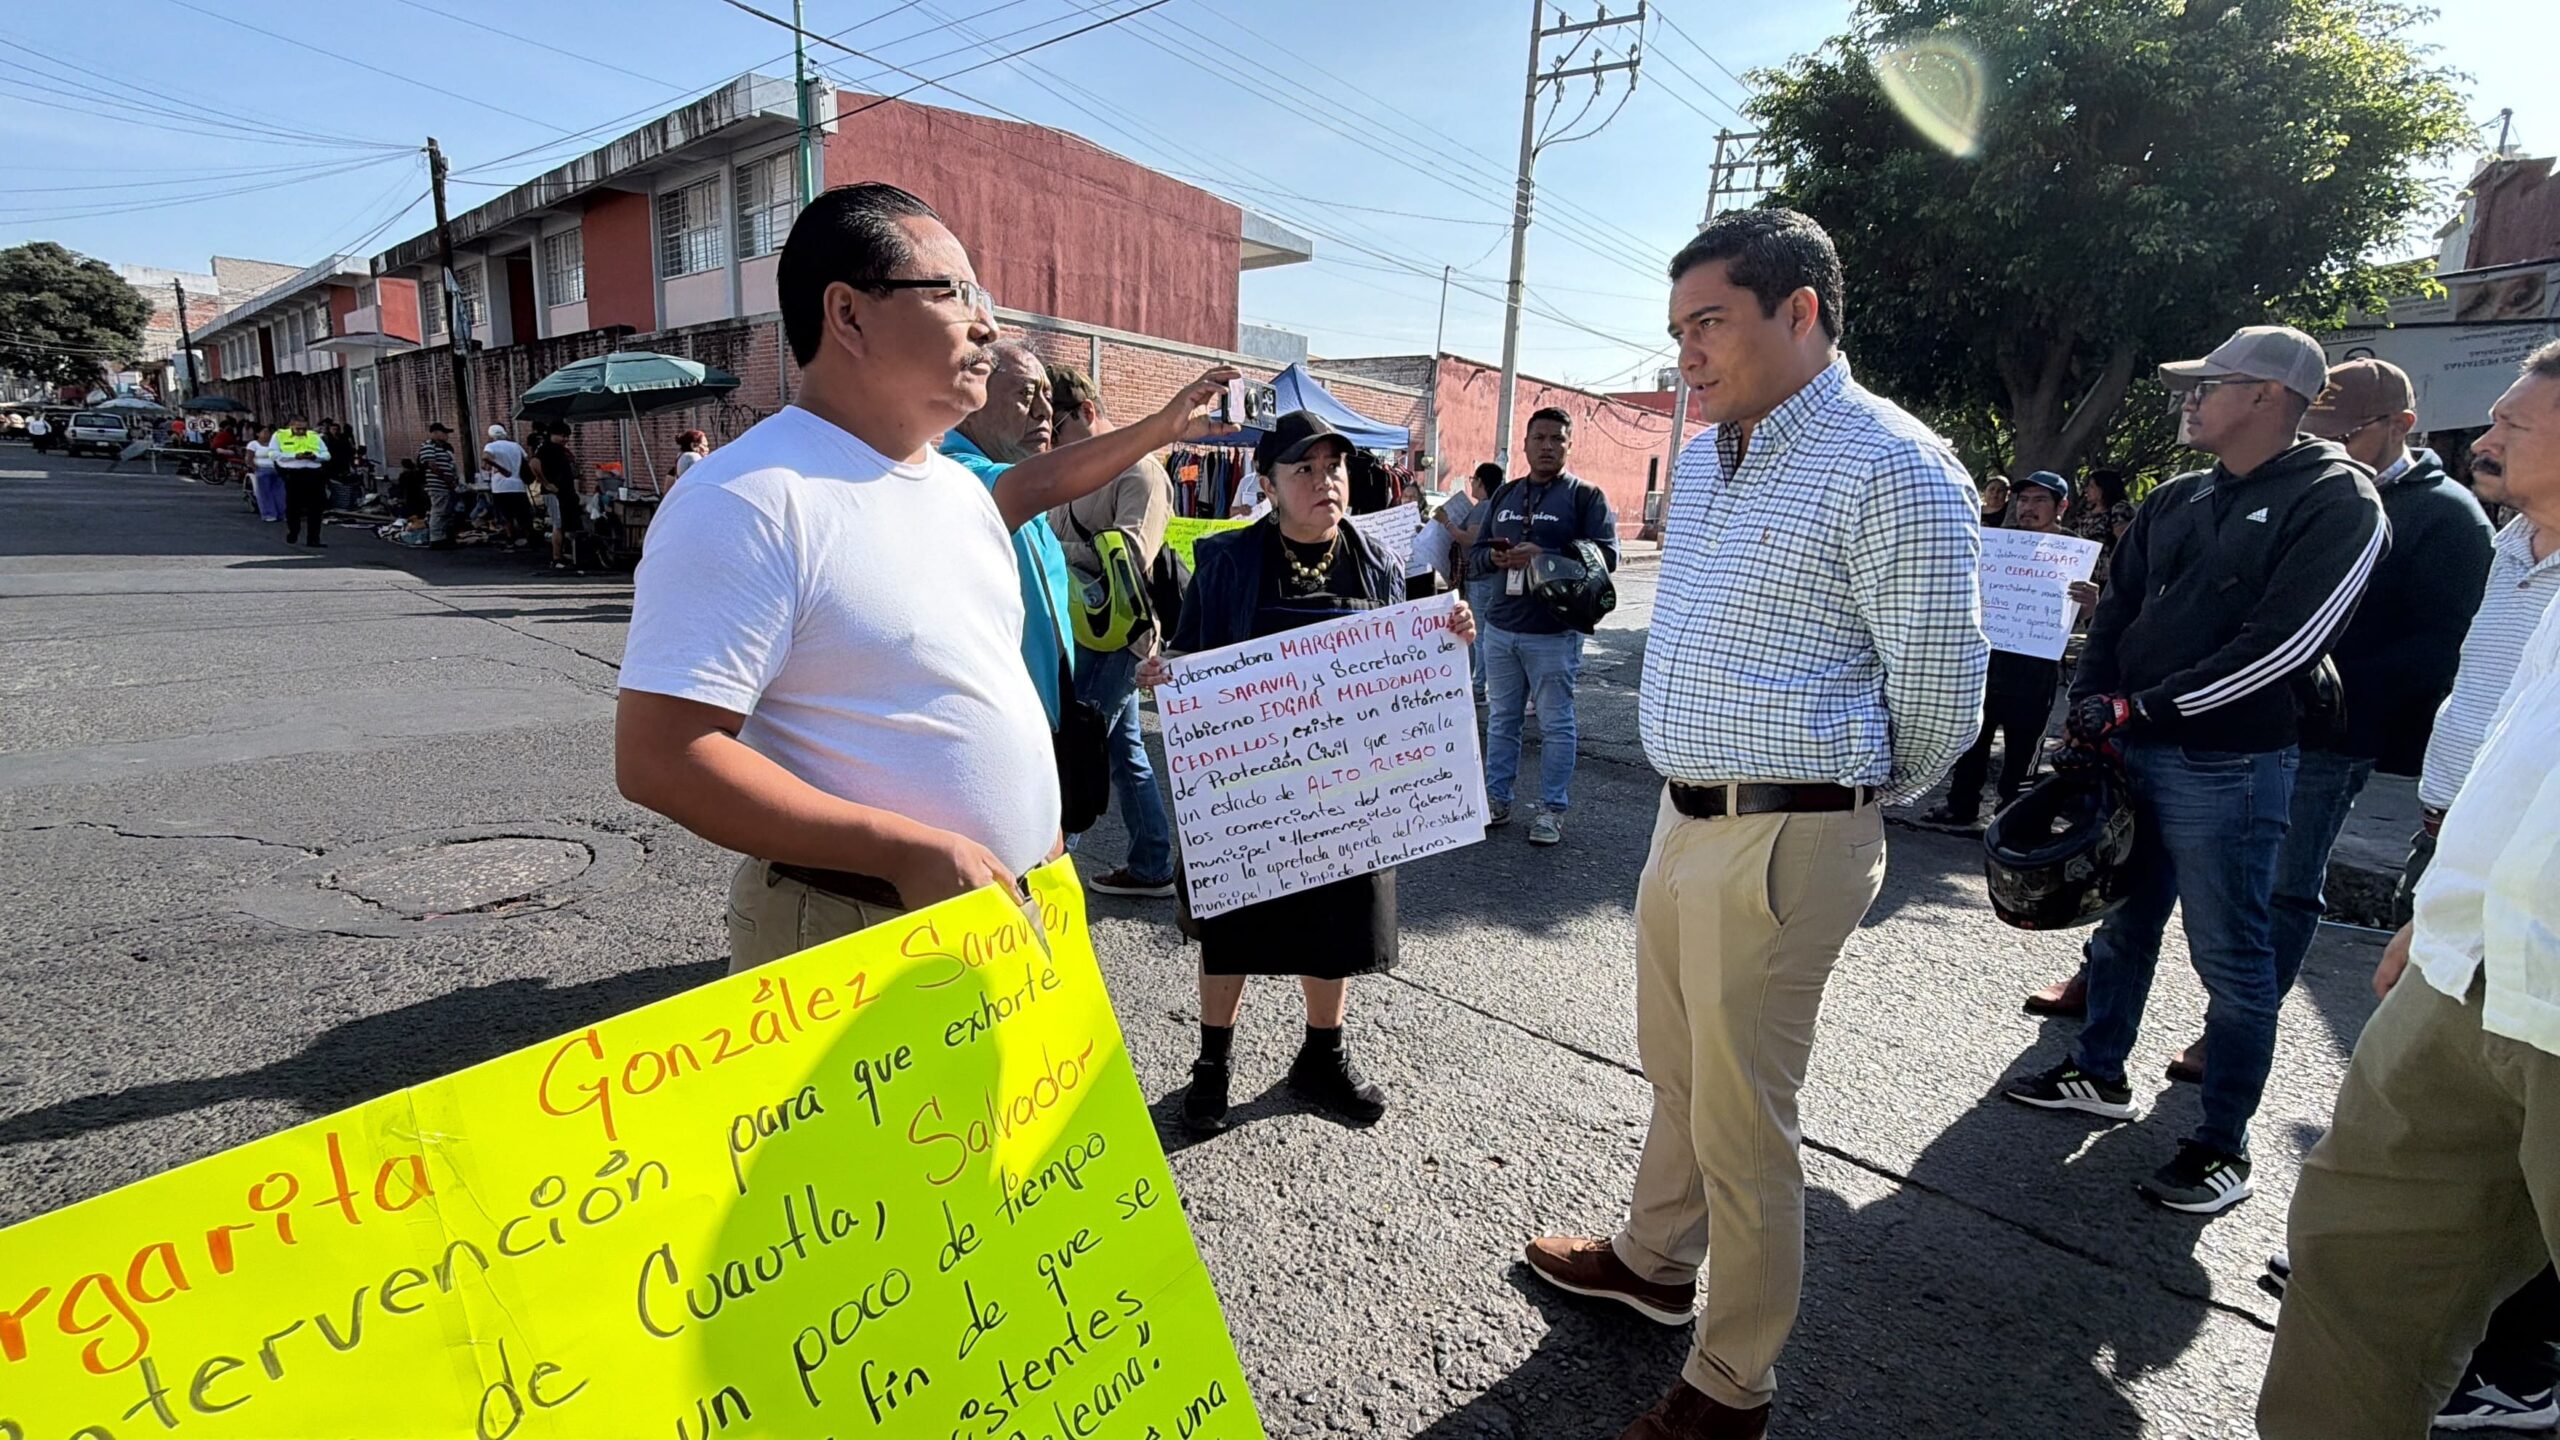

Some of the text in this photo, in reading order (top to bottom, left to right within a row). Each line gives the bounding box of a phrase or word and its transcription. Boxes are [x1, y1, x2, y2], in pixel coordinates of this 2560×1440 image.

[1498, 509, 1559, 526] Chapion
[2030, 551, 2080, 566] EDGAR
[1163, 652, 1273, 694] Gobernadora
[1280, 620, 1396, 660] MARGARITA
[1218, 672, 1306, 705] SARAVIA,
[1330, 645, 1427, 678] Secretario
[1437, 634, 1456, 654] de
[1168, 664, 1452, 748] Gobierno EDGAR MALDONADO
[1171, 732, 1288, 774] CEBALLOS,
[1293, 711, 1344, 739] existe
[1357, 707, 1380, 721] un
[1175, 712, 1454, 801] de Protección Civil que señala
[1178, 741, 1455, 826] un estado de ALTO RIESGO a
[1184, 767, 1453, 847] los comerciantes del mercado
[1189, 840, 1271, 870] municipal
[1191, 803, 1477, 899] pero la apretada agenda del Presidente
[1280, 879, 1292, 891] le
[538, 967, 882, 1142] González
[0, 962, 1062, 1440] tervención para que exhorte
[475, 1038, 1094, 1440] de Cuautla, Salvador
[676, 1132, 1106, 1440] un poco de tiempo
[860, 1175, 1161, 1426] fin de que se
[1176, 1379, 1228, 1440] una
